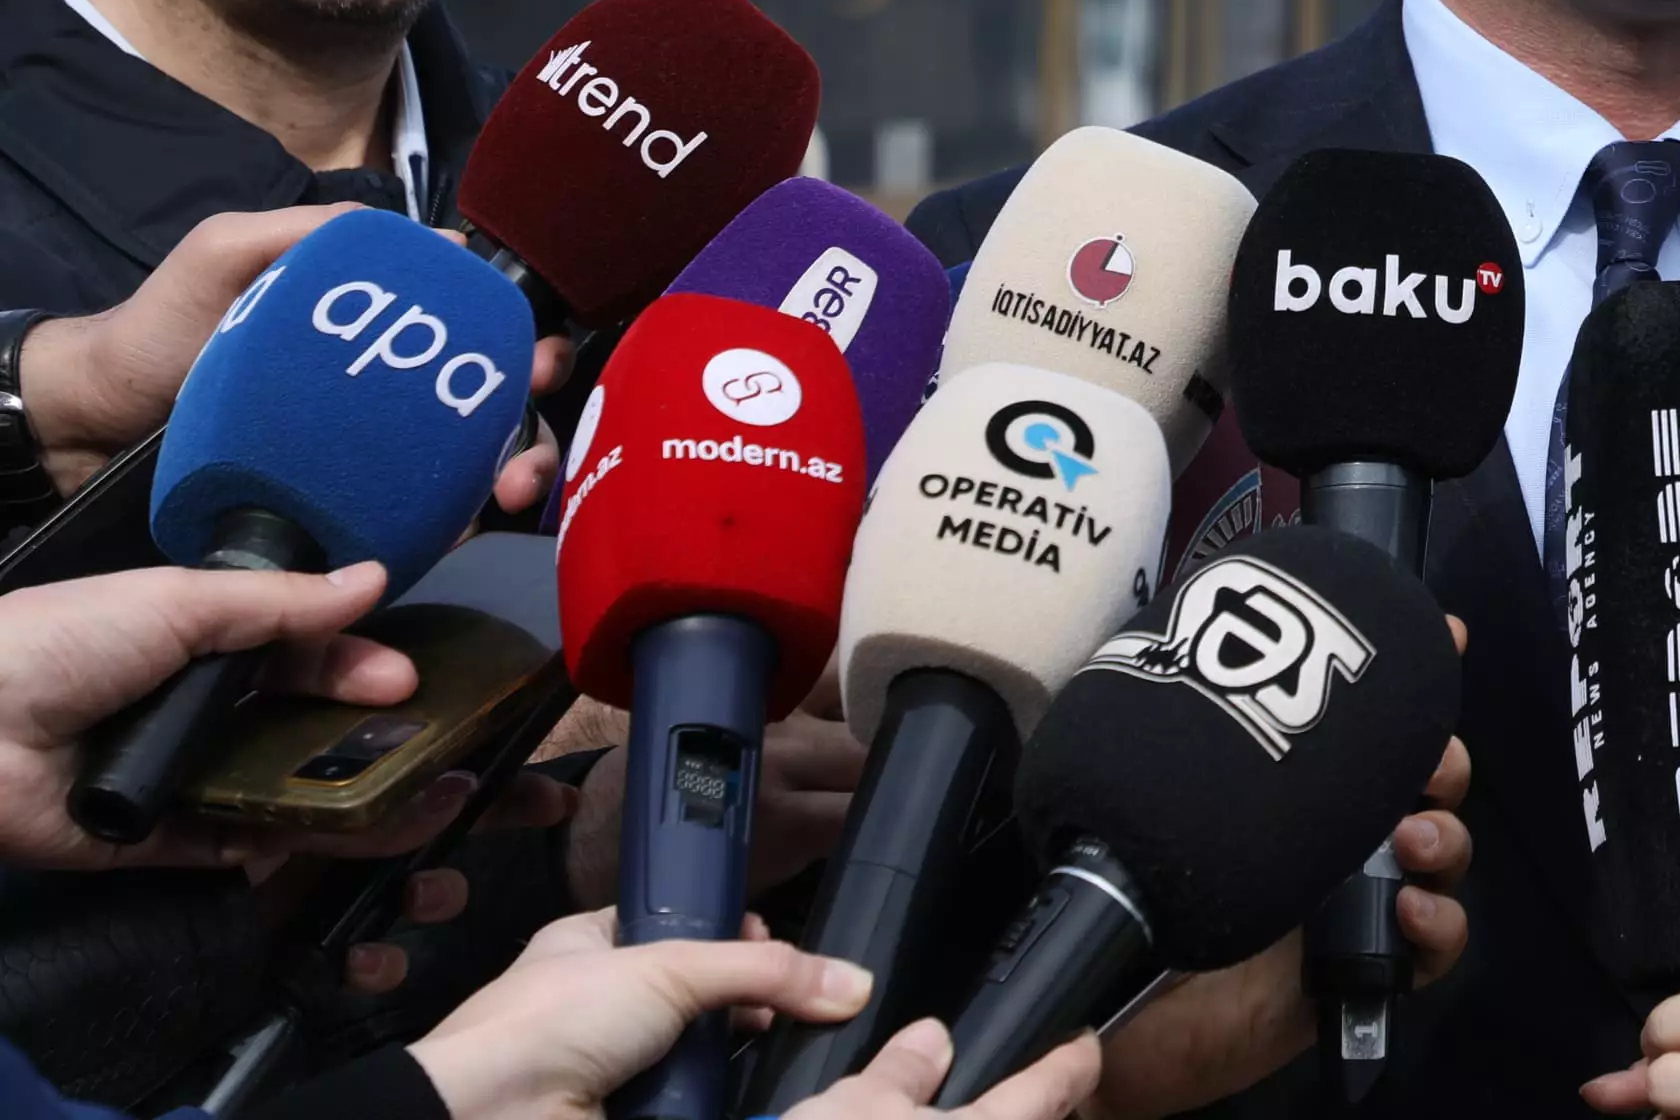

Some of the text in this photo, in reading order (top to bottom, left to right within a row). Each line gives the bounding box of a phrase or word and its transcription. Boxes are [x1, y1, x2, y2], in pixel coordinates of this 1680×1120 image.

[536, 40, 708, 179] trend
[1274, 249, 1503, 324] baku TV
[311, 280, 507, 418] apa
[991, 282, 1161, 375] İQTİSADİYYAT.AZ
[661, 435, 844, 484] modern.az
[919, 472, 1113, 548] OPERATİV
[936, 514, 1062, 574] MEDİA
